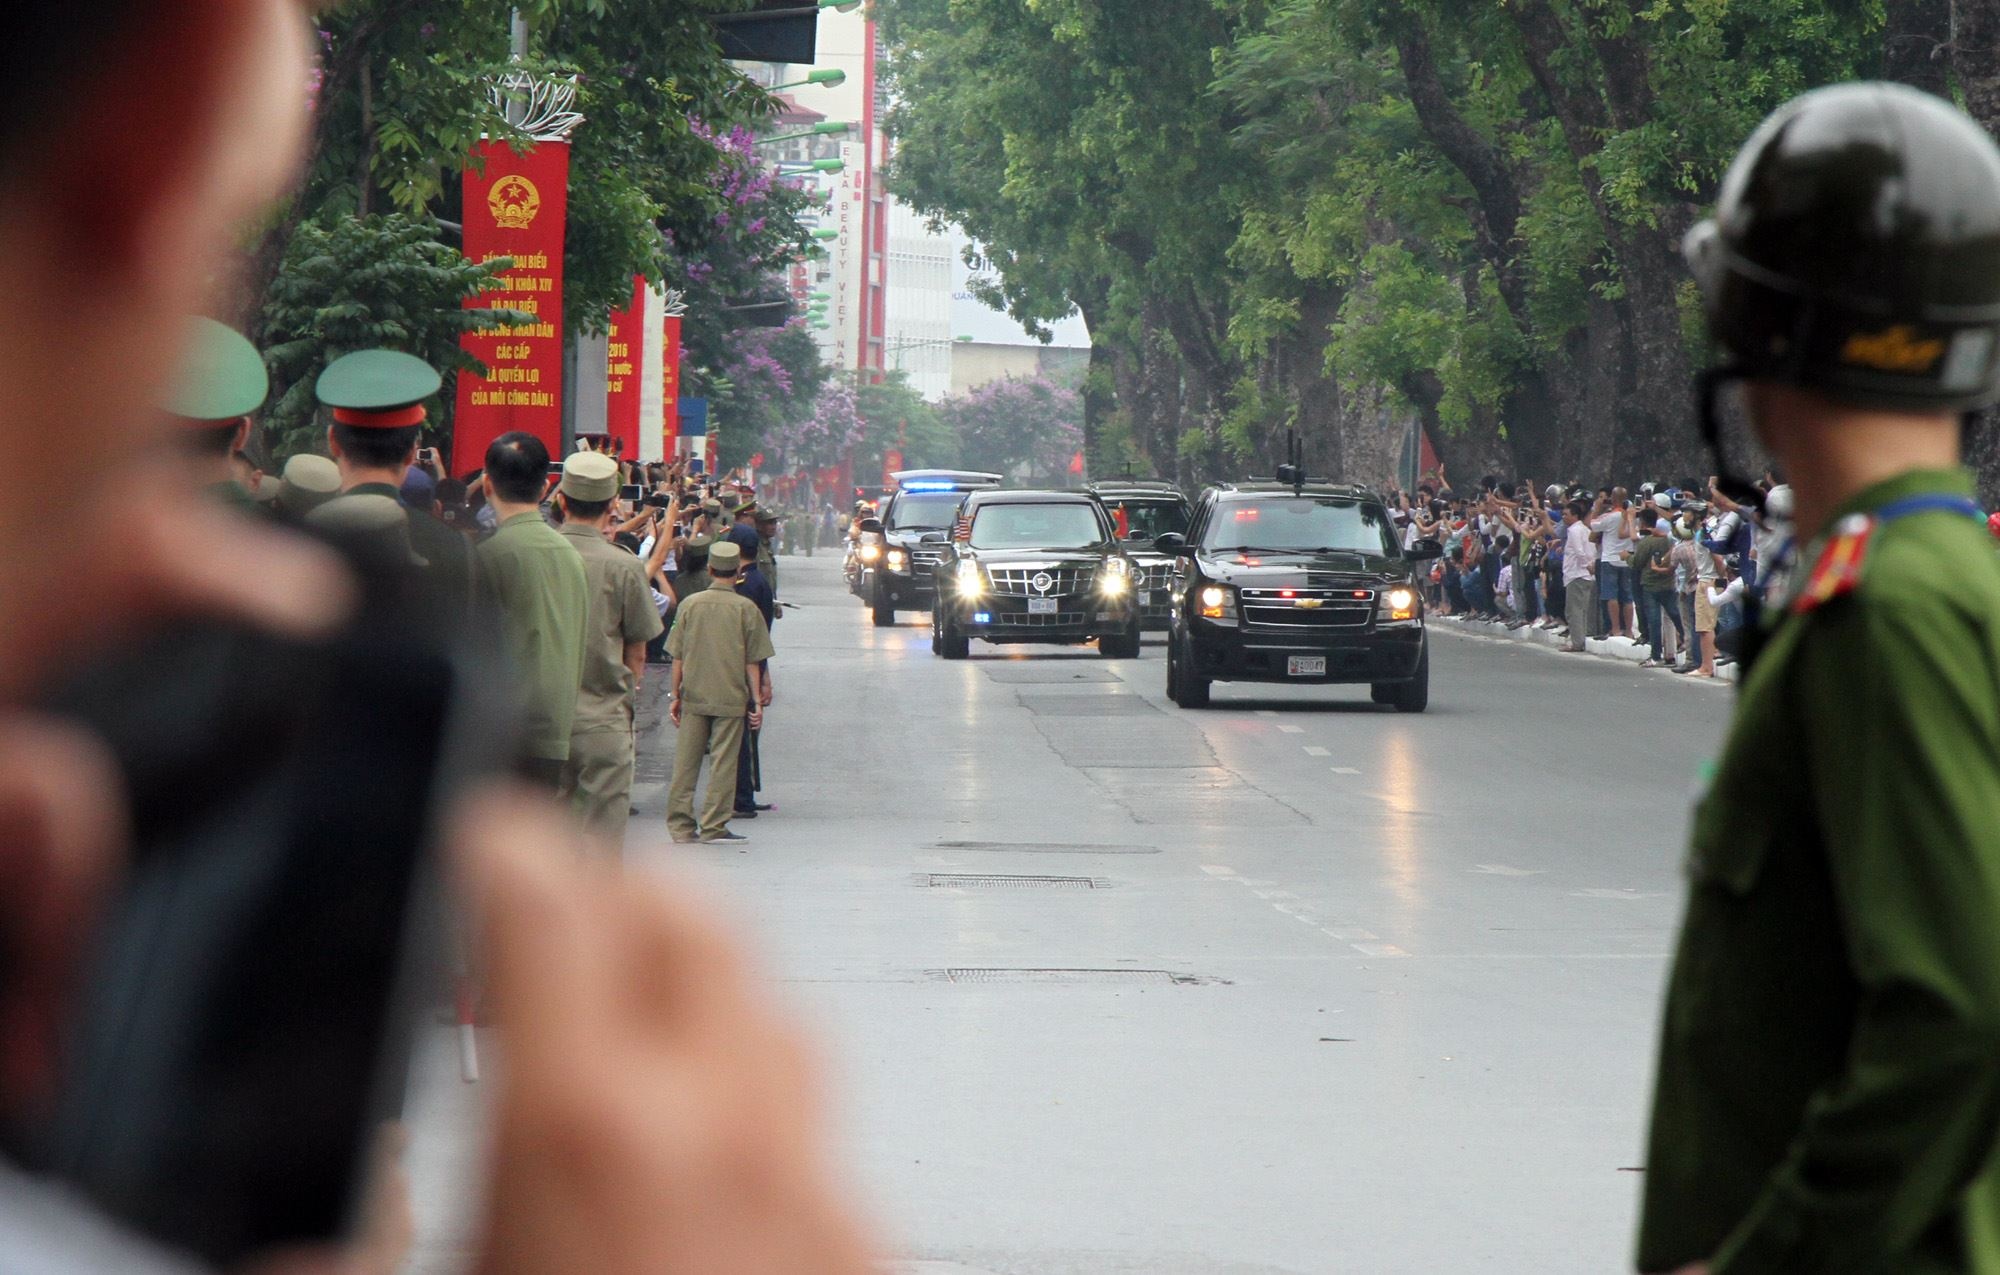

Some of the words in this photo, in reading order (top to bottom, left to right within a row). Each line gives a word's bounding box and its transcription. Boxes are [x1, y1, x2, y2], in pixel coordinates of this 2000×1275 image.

[840, 202, 848, 269] BEAUTY
[539, 278, 552, 291] XIV
[496, 342, 512, 359] CÁC
[514, 341, 530, 359] CẤP
[472, 386, 488, 405] CỦA
[507, 389, 529, 405] CÔNG
[531, 390, 548, 406] DÂN
